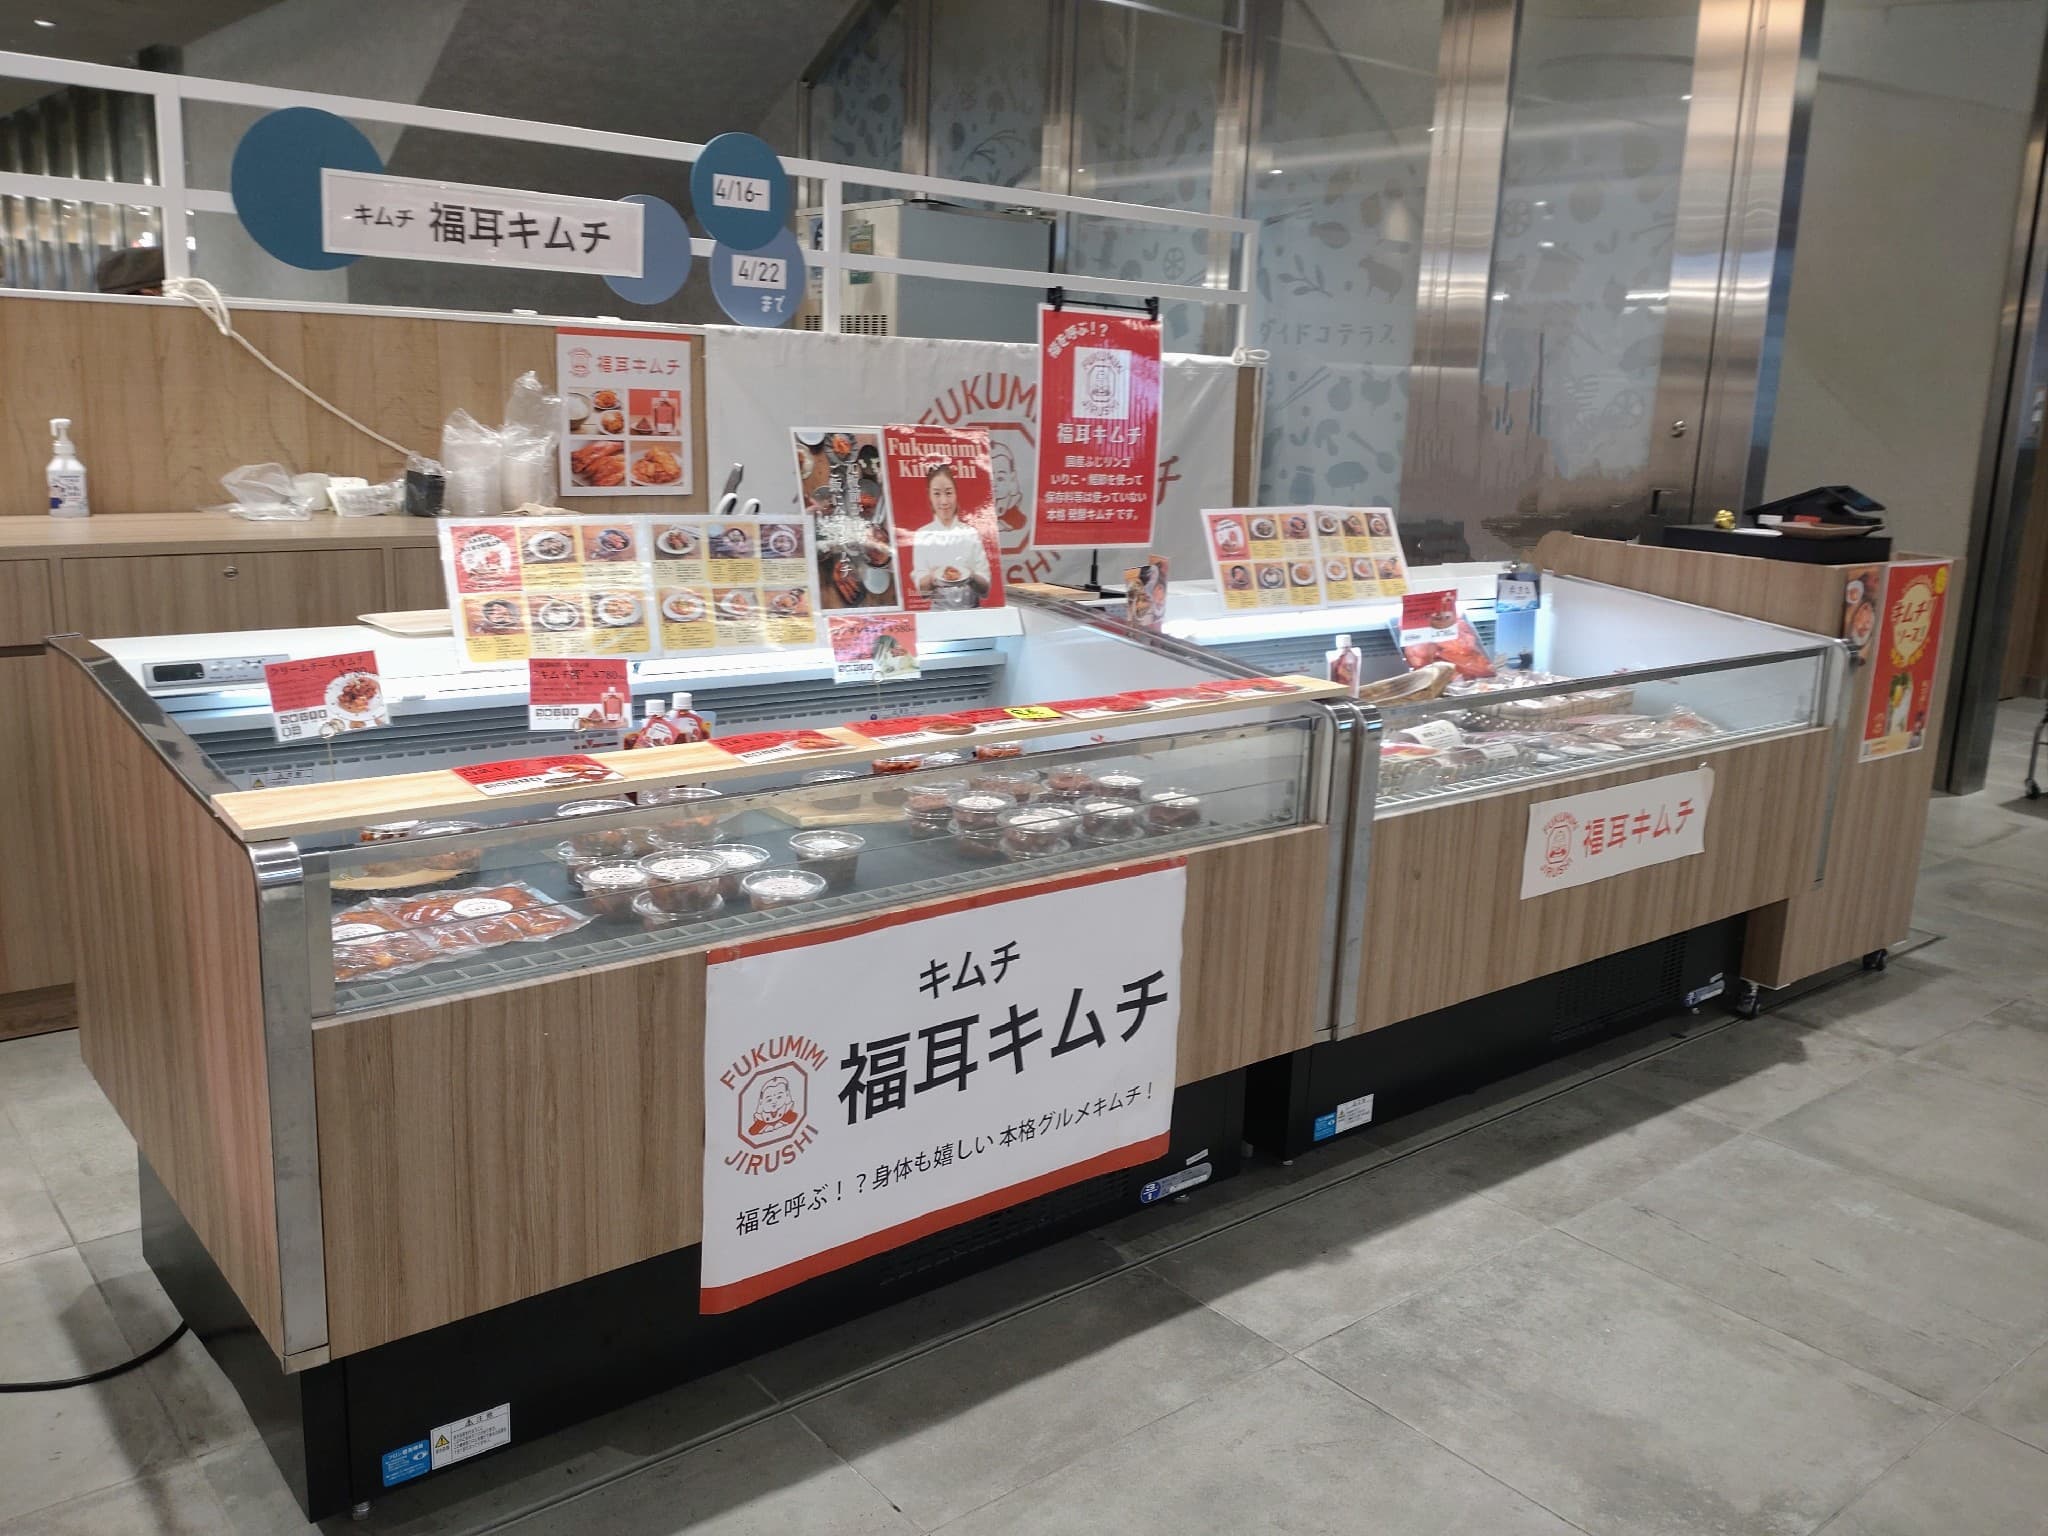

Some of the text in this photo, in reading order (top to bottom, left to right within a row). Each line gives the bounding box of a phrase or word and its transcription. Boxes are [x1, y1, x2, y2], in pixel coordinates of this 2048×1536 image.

[353, 201, 612, 254] キムチ 福耳キムチ
[738, 260, 780, 283] 4/22
[760, 295, 786, 313] まで
[1259, 319, 1395, 347] ダイドコテラス
[596, 354, 681, 376] 福耳キムチ
[887, 437, 982, 458] Fukumimi
[1056, 422, 1142, 445] 福耳キムチ
[1582, 797, 1695, 859] 福耳キムチ
[918, 939, 1021, 1000] キムチ
[719, 1035, 829, 1090] FUKUMIMI
[837, 969, 1169, 1125] 福耳キムチ
[724, 1123, 820, 1176] JIRUSHI
